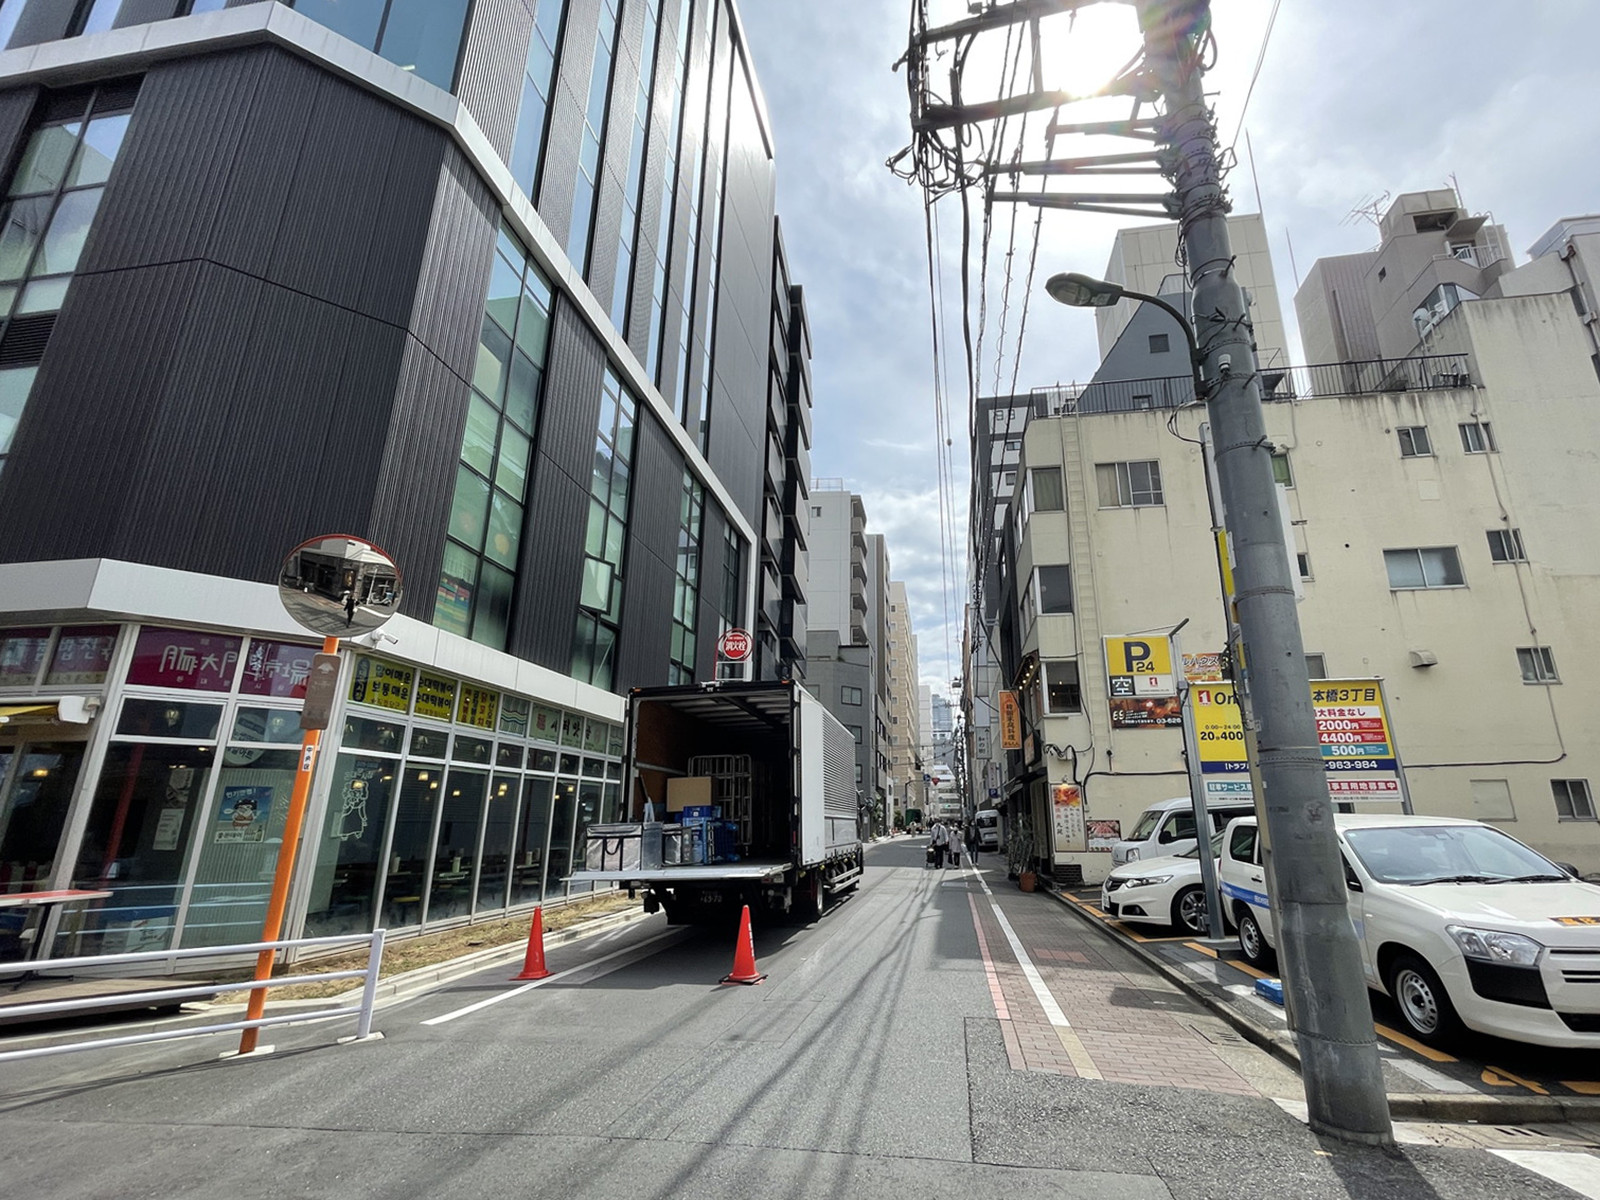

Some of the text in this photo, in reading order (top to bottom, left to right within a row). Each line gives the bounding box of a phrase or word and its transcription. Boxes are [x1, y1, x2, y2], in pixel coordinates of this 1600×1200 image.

[726, 641, 746, 651] 消火栓
[1124, 641, 1151, 672] P
[1136, 661, 1155, 672] 24
[1112, 676, 1133, 695] 空
[1313, 708, 1366, 717] 大料金なし
[1319, 720, 1359, 730] 2000円
[1321, 732, 1362, 742] 4400円
[1331, 745, 1365, 755] 500円
